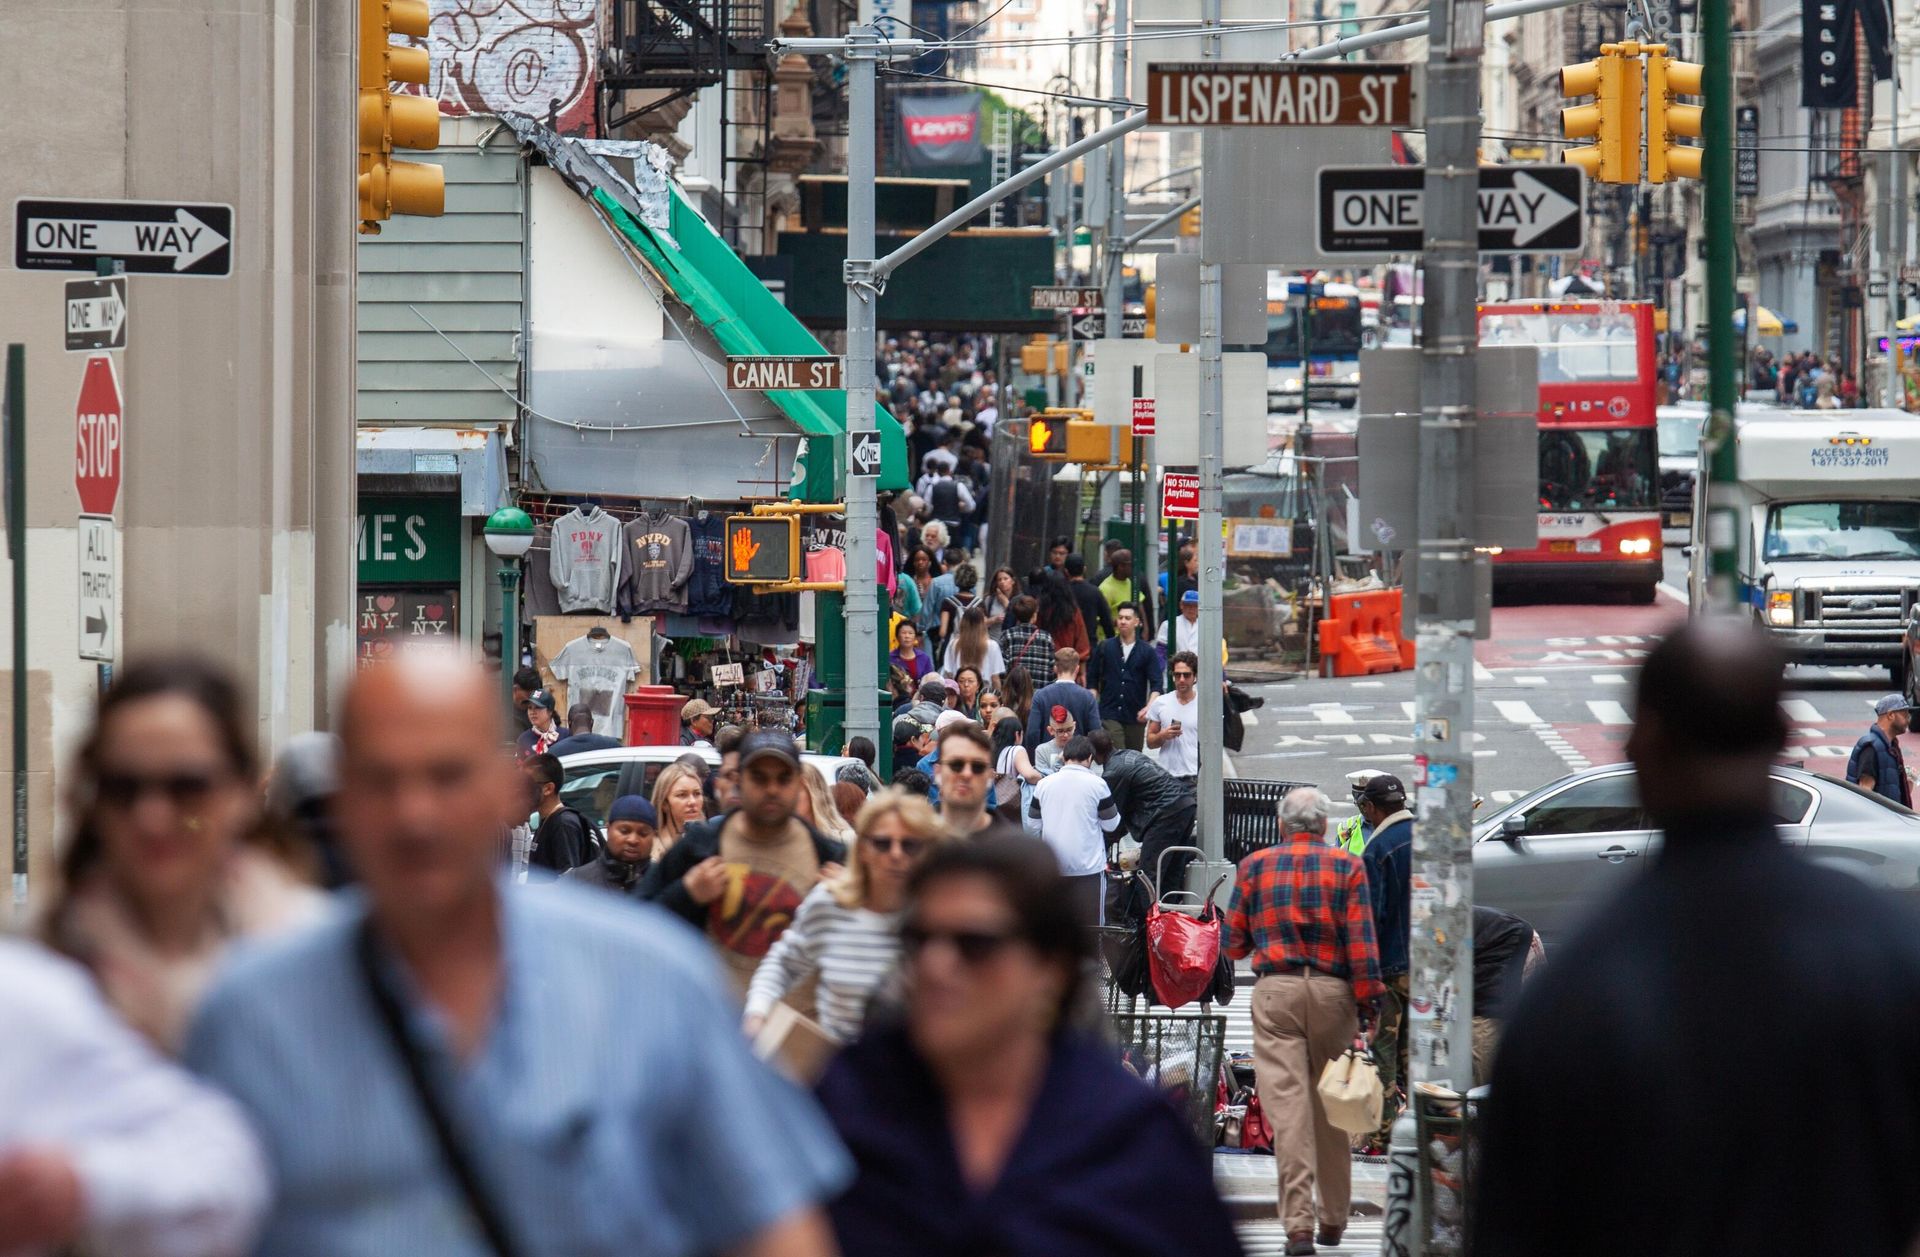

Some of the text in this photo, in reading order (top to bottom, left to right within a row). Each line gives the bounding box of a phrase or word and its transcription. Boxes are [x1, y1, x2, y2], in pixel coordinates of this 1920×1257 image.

[1161, 75, 1397, 124] LISPENARD ST
[1343, 194, 1419, 226] ONE
[35, 222, 203, 252] ONE WAY
[1033, 290, 1098, 307] HOWARD ST
[71, 301, 119, 329] ONE WAY
[733, 363, 835, 388] CANAL ST
[77, 414, 119, 478] STOP
[860, 446, 878, 463] ONE
[1811, 448, 1889, 457] ACCESS-A-RIDE
[1811, 457, 1889, 466] 1-877-337-2017
[1167, 479, 1177, 487] NO
[1167, 488, 1195, 499] Anytime
[87, 526, 107, 562] ALL
[571, 531, 603, 543] FDNY
[635, 533, 672, 549] NYPD
[82, 571, 111, 599] TRAFFIC
[361, 612, 399, 629] NY
[411, 621, 447, 635] NY
